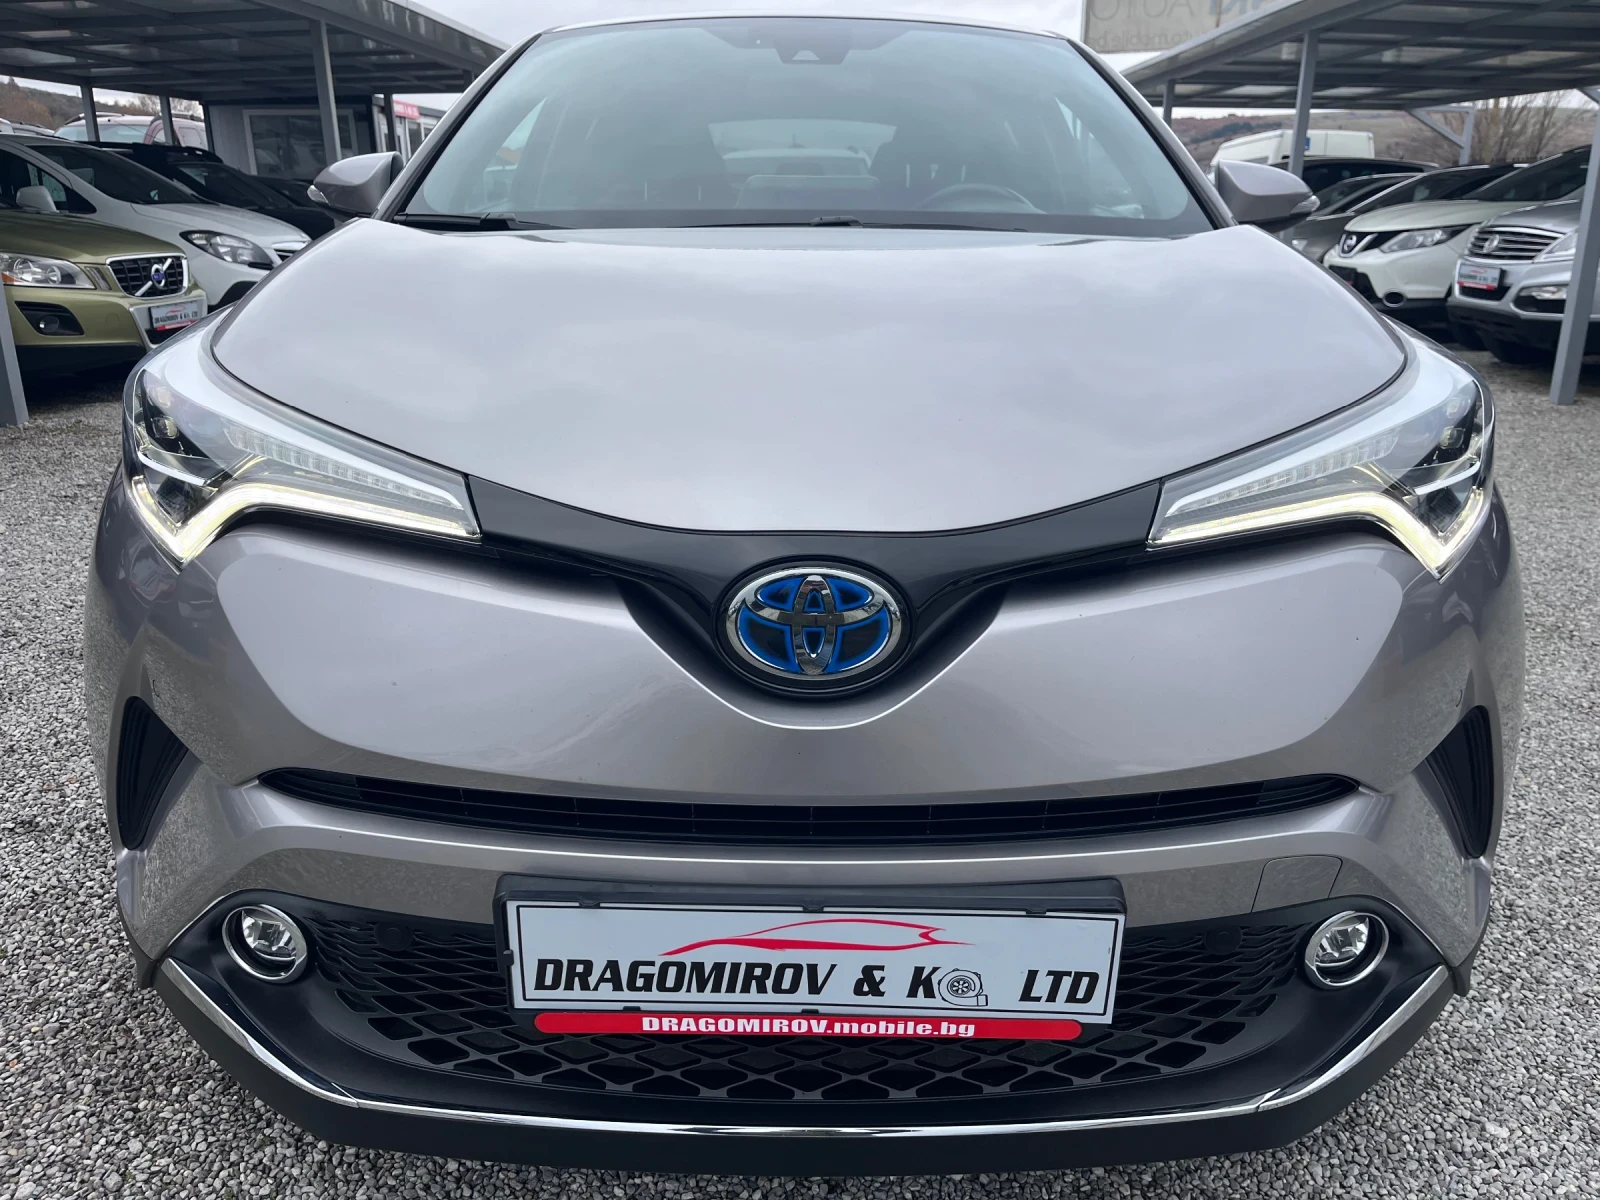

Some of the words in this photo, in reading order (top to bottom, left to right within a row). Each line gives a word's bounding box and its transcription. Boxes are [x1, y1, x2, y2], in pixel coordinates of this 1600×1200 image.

[534, 958, 838, 995] DRAGOMIROV
[853, 964, 886, 998] &
[1018, 969, 1100, 1004] LTD
[642, 1016, 976, 1038] DRAGOMIROV.mobile.bg
